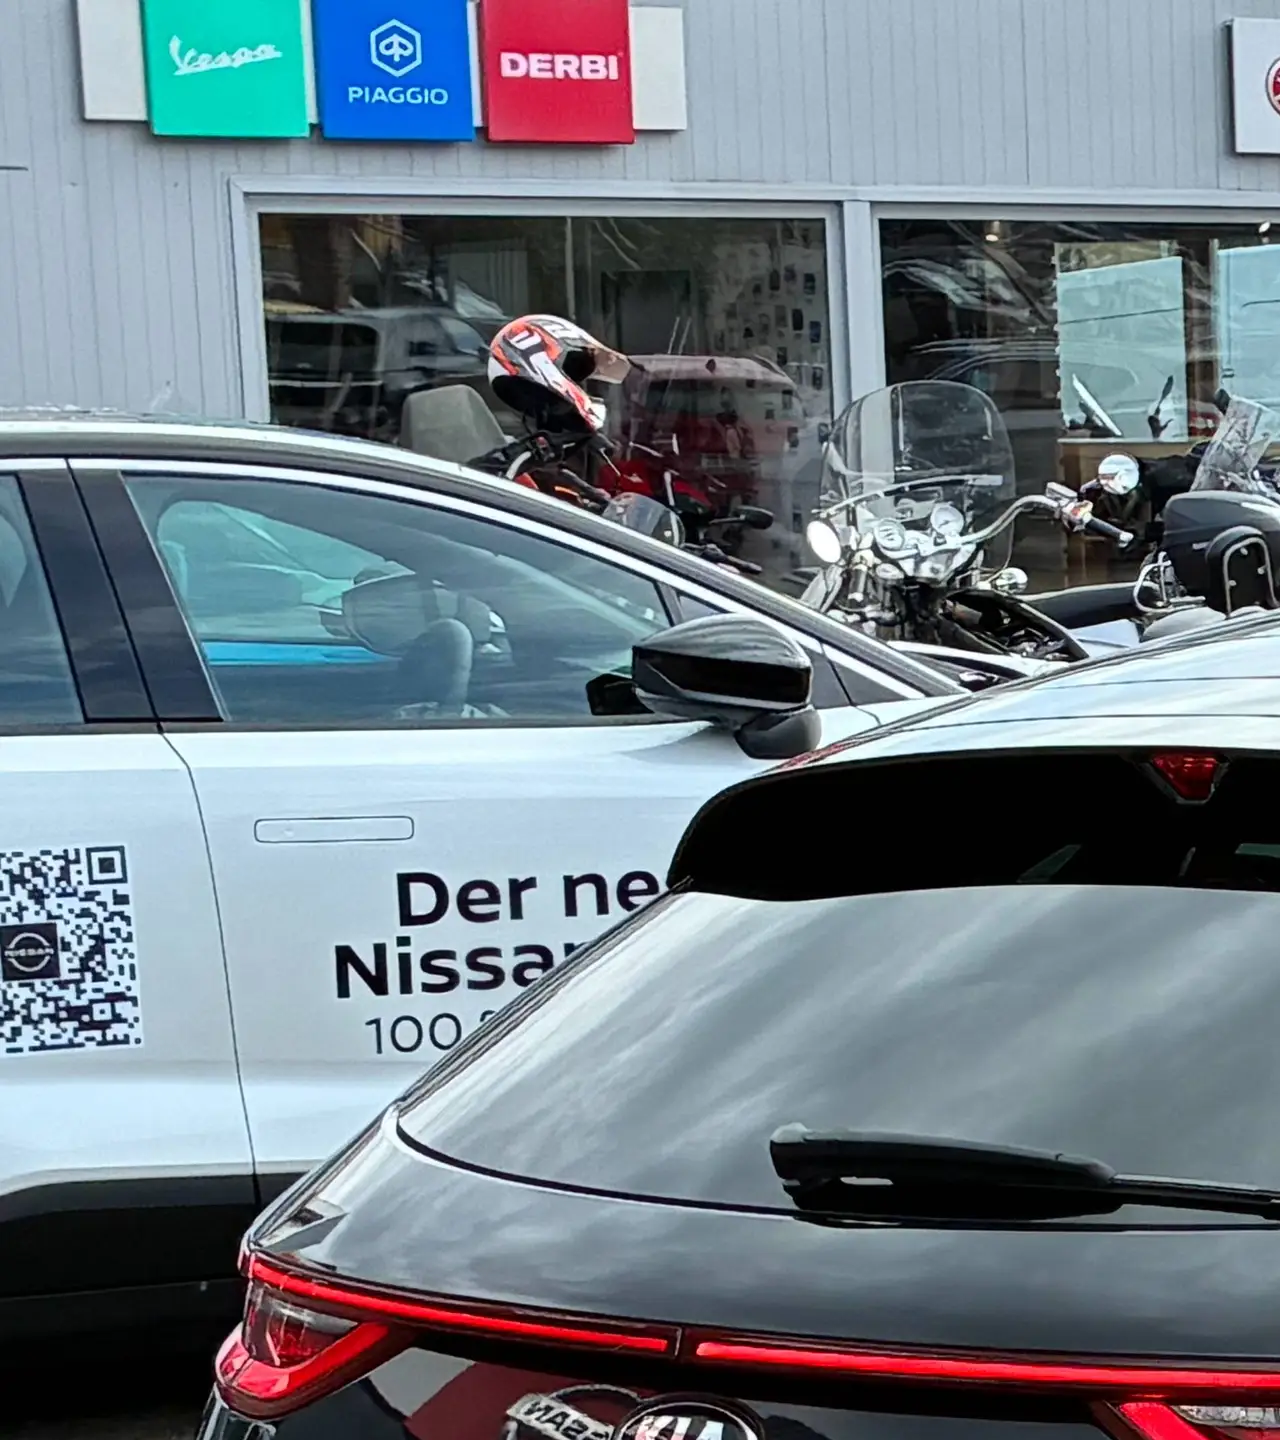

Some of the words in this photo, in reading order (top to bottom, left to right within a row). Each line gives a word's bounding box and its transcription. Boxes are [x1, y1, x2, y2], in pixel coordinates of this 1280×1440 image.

[169, 35, 283, 76] Vespa
[500, 52, 620, 81] DERBI
[347, 85, 449, 105] PIAGGIO
[396, 872, 538, 927] Der
[563, 870, 660, 917] ne
[364, 1012, 462, 1054] 100
